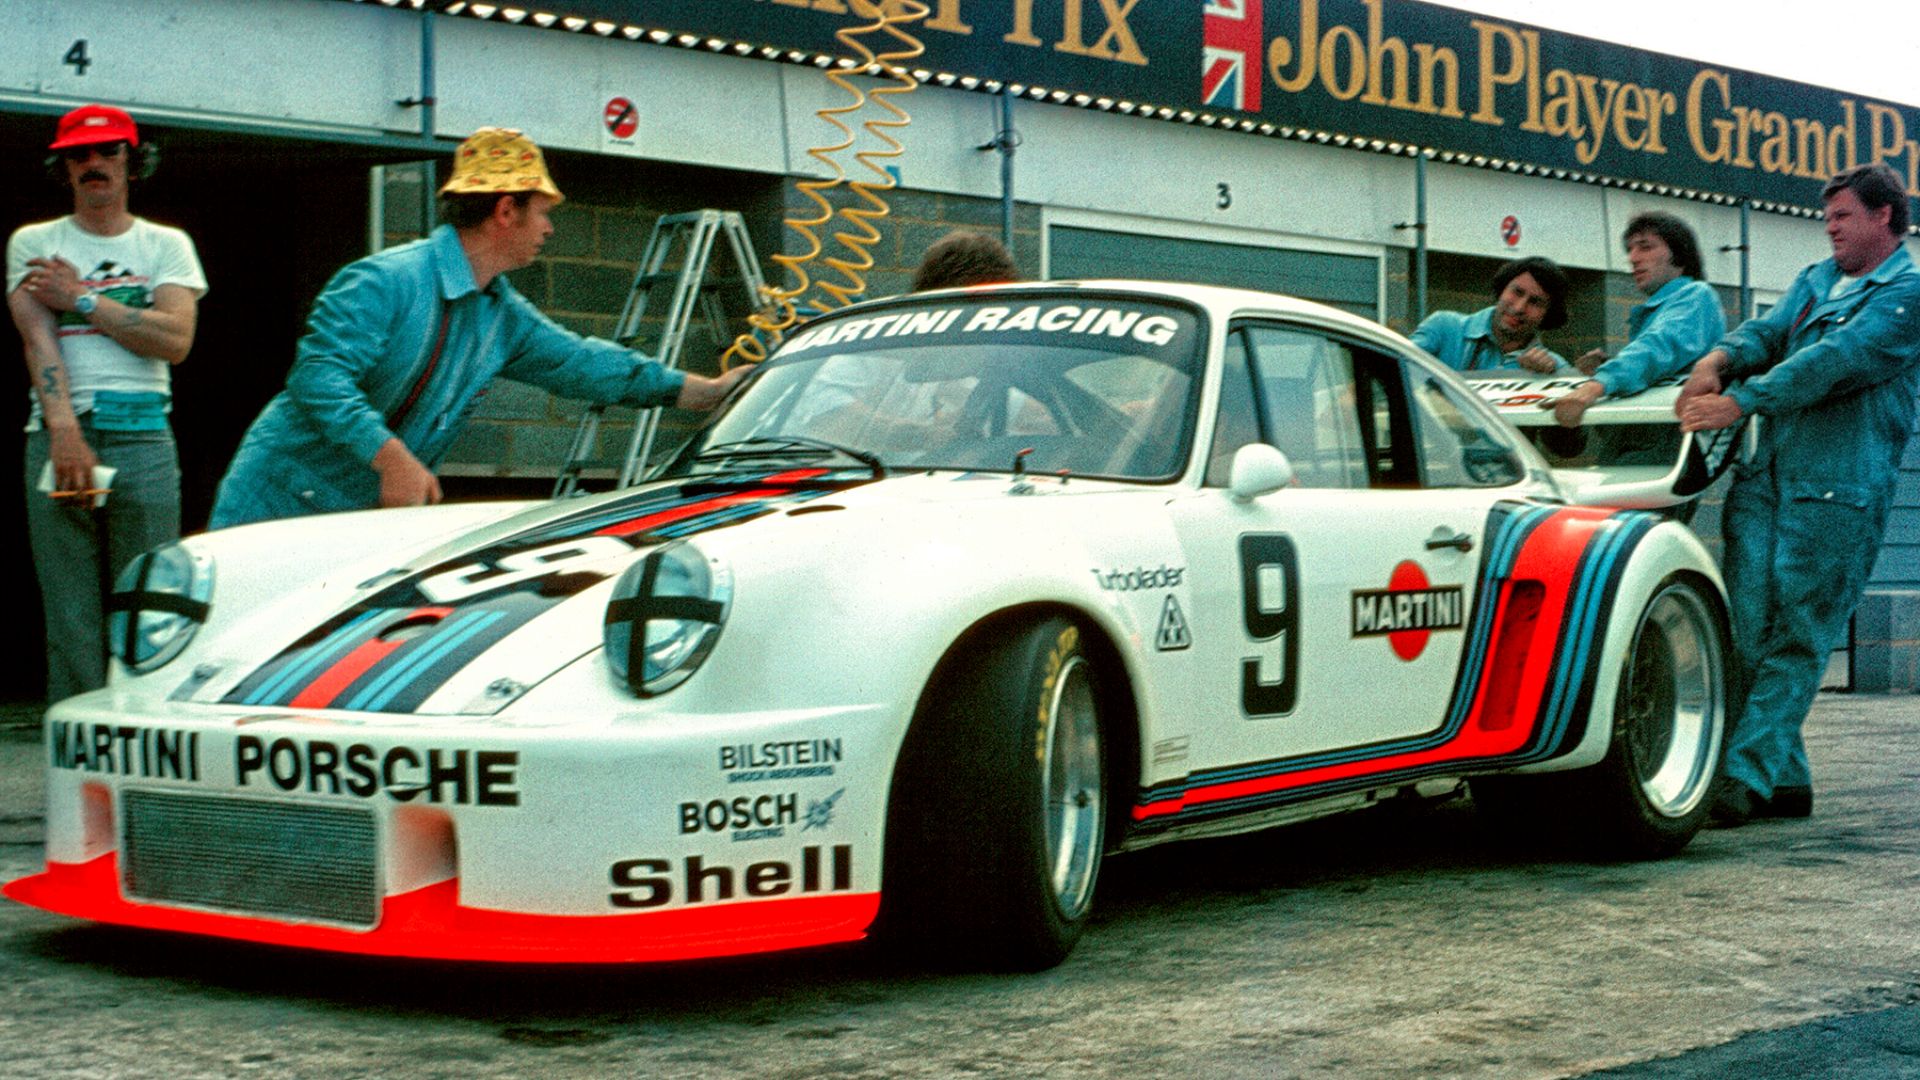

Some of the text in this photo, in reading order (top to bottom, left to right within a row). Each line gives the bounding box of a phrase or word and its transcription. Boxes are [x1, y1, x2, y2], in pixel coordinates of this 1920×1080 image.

[62, 39, 92, 76] 4
[1268, 0, 1464, 118] John
[1471, 20, 1677, 164] Player
[1685, 68, 1857, 182] Grand
[1216, 184, 1233, 210] 3
[769, 305, 1179, 361] MARTINI RACING
[1090, 564, 1185, 591] Turbolader
[1239, 532, 1299, 718] 9
[1355, 591, 1461, 632] MARTINI
[51, 720, 521, 807] MARTINI PORSCHE
[720, 737, 843, 770] BILSTEIN
[680, 793, 798, 835] BOSCH
[609, 844, 853, 909] Shell
